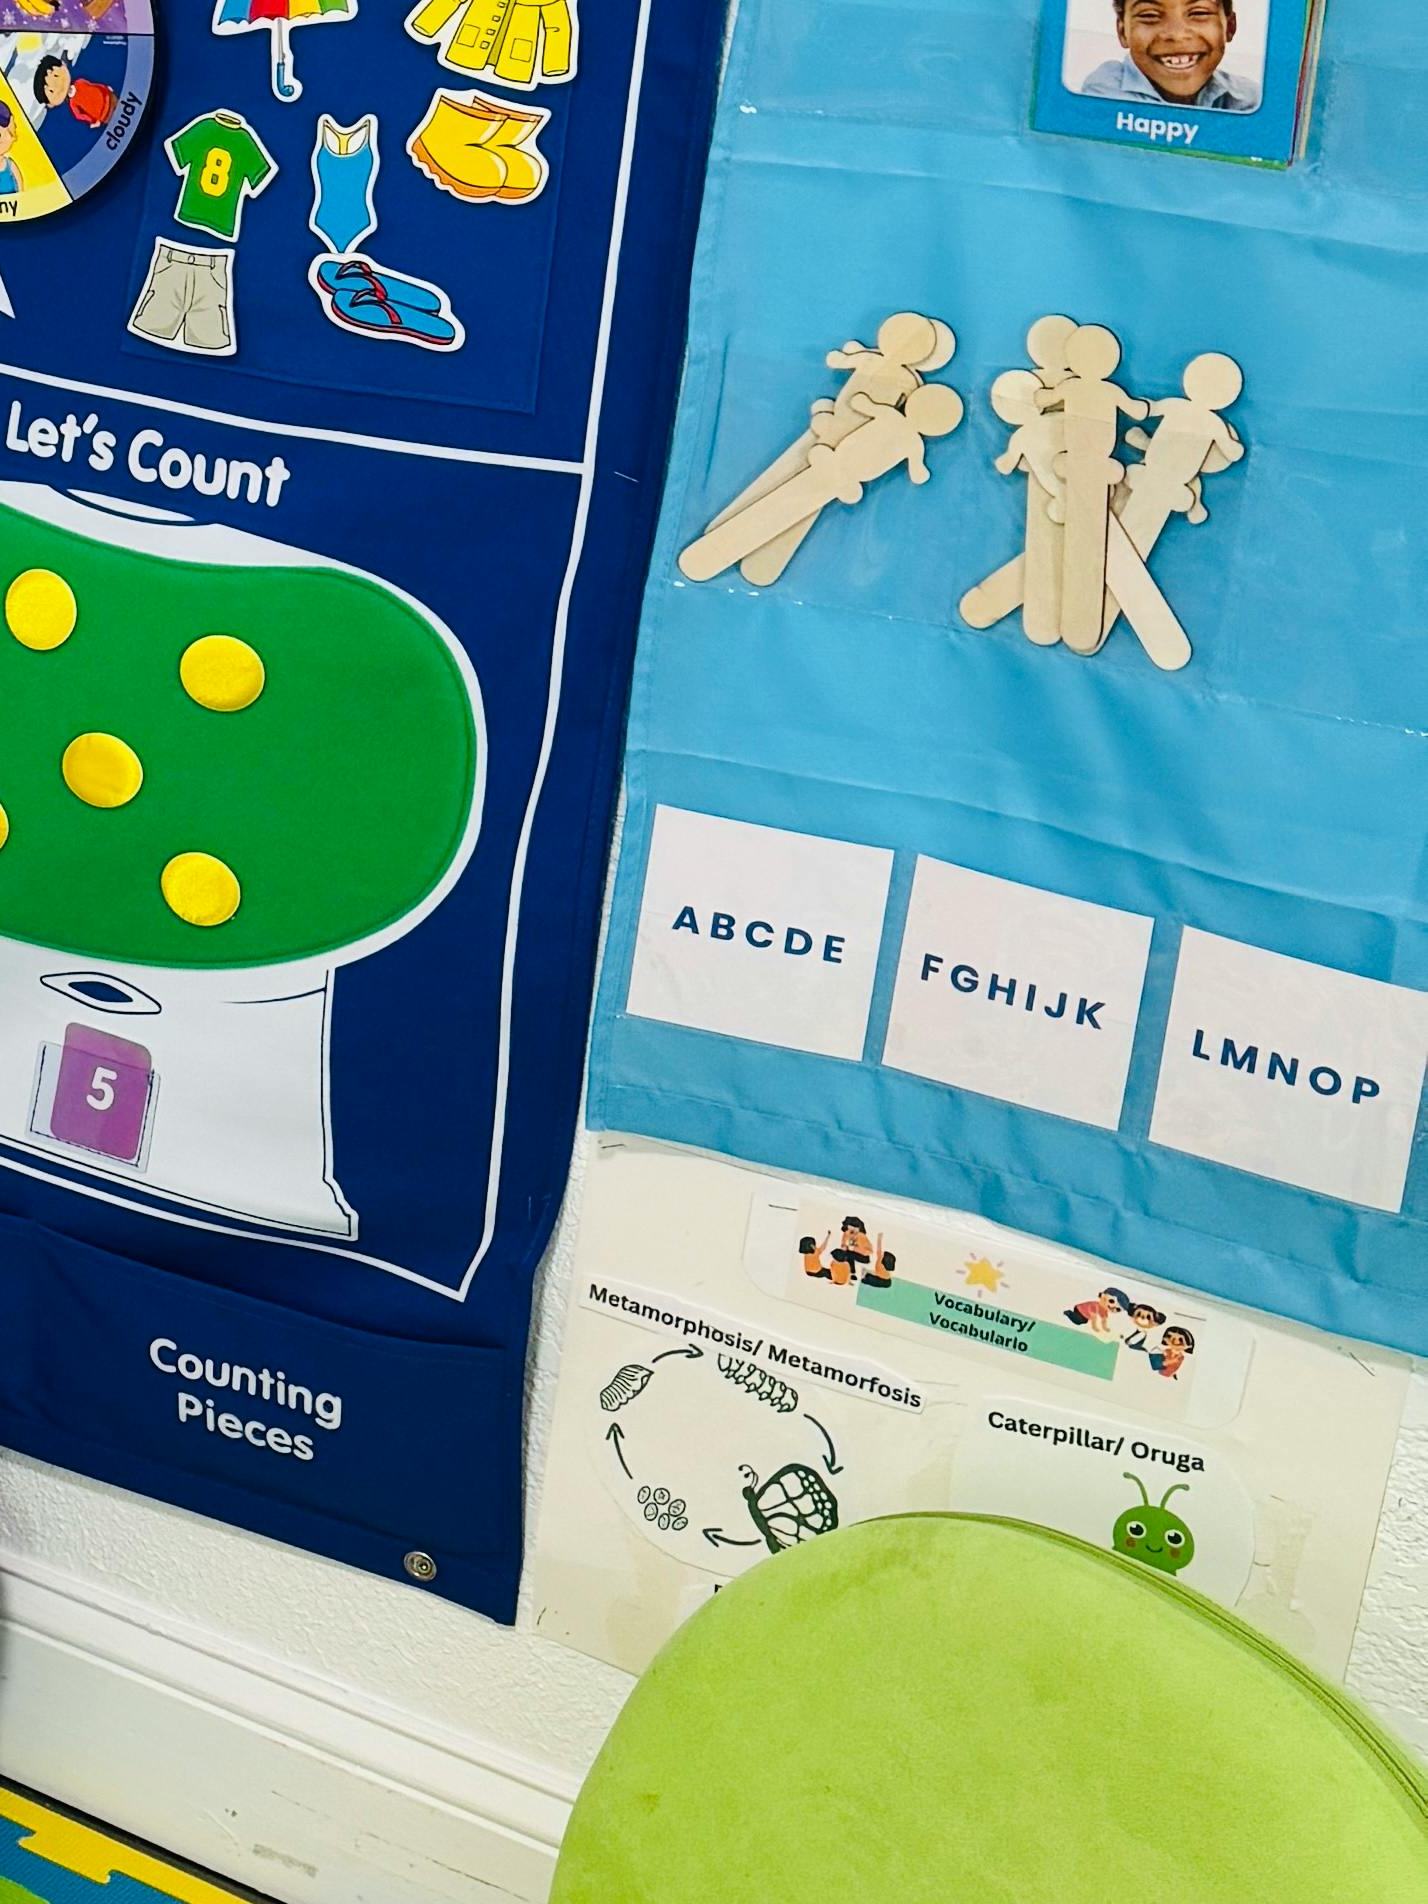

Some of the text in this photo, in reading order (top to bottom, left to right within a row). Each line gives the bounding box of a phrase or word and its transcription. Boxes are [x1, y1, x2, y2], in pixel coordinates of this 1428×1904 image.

[104, 92, 145, 153] cloudy
[1115, 112, 1200, 146] Happy
[6, 400, 292, 507] Let's Count
[86, 1066, 116, 1111] 5
[933, 1289, 1037, 1334] Vocabulary/
[588, 1282, 924, 1411] Metamorphosis/ Metamorfosis
[148, 1337, 343, 1431] Counting
[177, 1391, 315, 1463] Pieces
[987, 1408, 1207, 1474] Caterpillar/ Oruga
